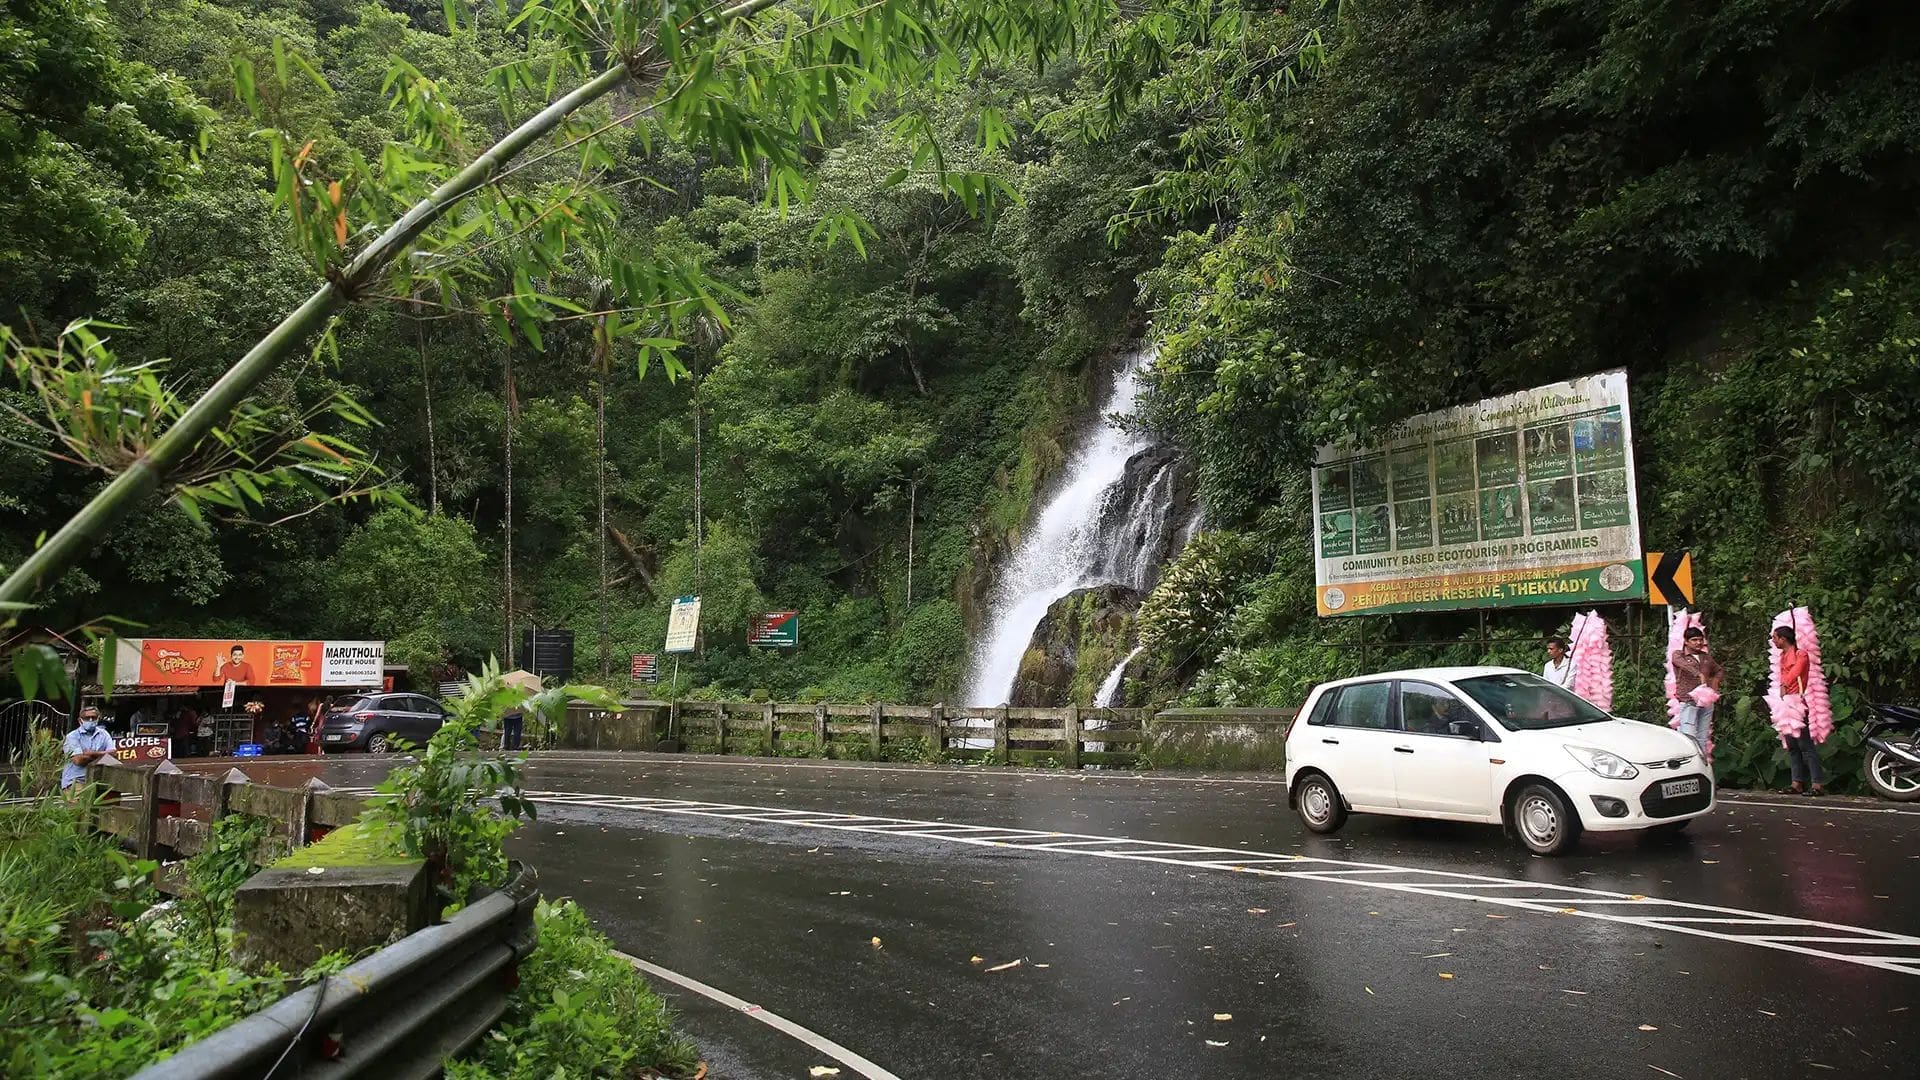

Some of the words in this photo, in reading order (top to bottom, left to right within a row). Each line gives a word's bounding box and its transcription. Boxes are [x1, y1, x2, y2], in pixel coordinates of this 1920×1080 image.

[1517, 400, 1539, 417] Enjoy
[1343, 557, 1399, 571] COMMUNITY
[1402, 552, 1434, 566] BASED
[1438, 545, 1508, 562] ECOTOURISM
[1511, 535, 1599, 556] PROGRAMMES
[1371, 583, 1402, 592] KERALA
[1404, 579, 1441, 590] FORESTS
[1443, 575, 1450, 586] &
[1495, 569, 1560, 584] DEPARTMENT
[1352, 592, 1399, 607] PERIYAR
[1401, 588, 1438, 602] TIGER
[1443, 584, 1505, 600] RESERVE,
[1508, 578, 1589, 596] THEKKADY
[325, 647, 383, 658] MARUTHOLIL
[118, 737, 161, 748] COFFEE
[116, 749, 138, 760] TEA
